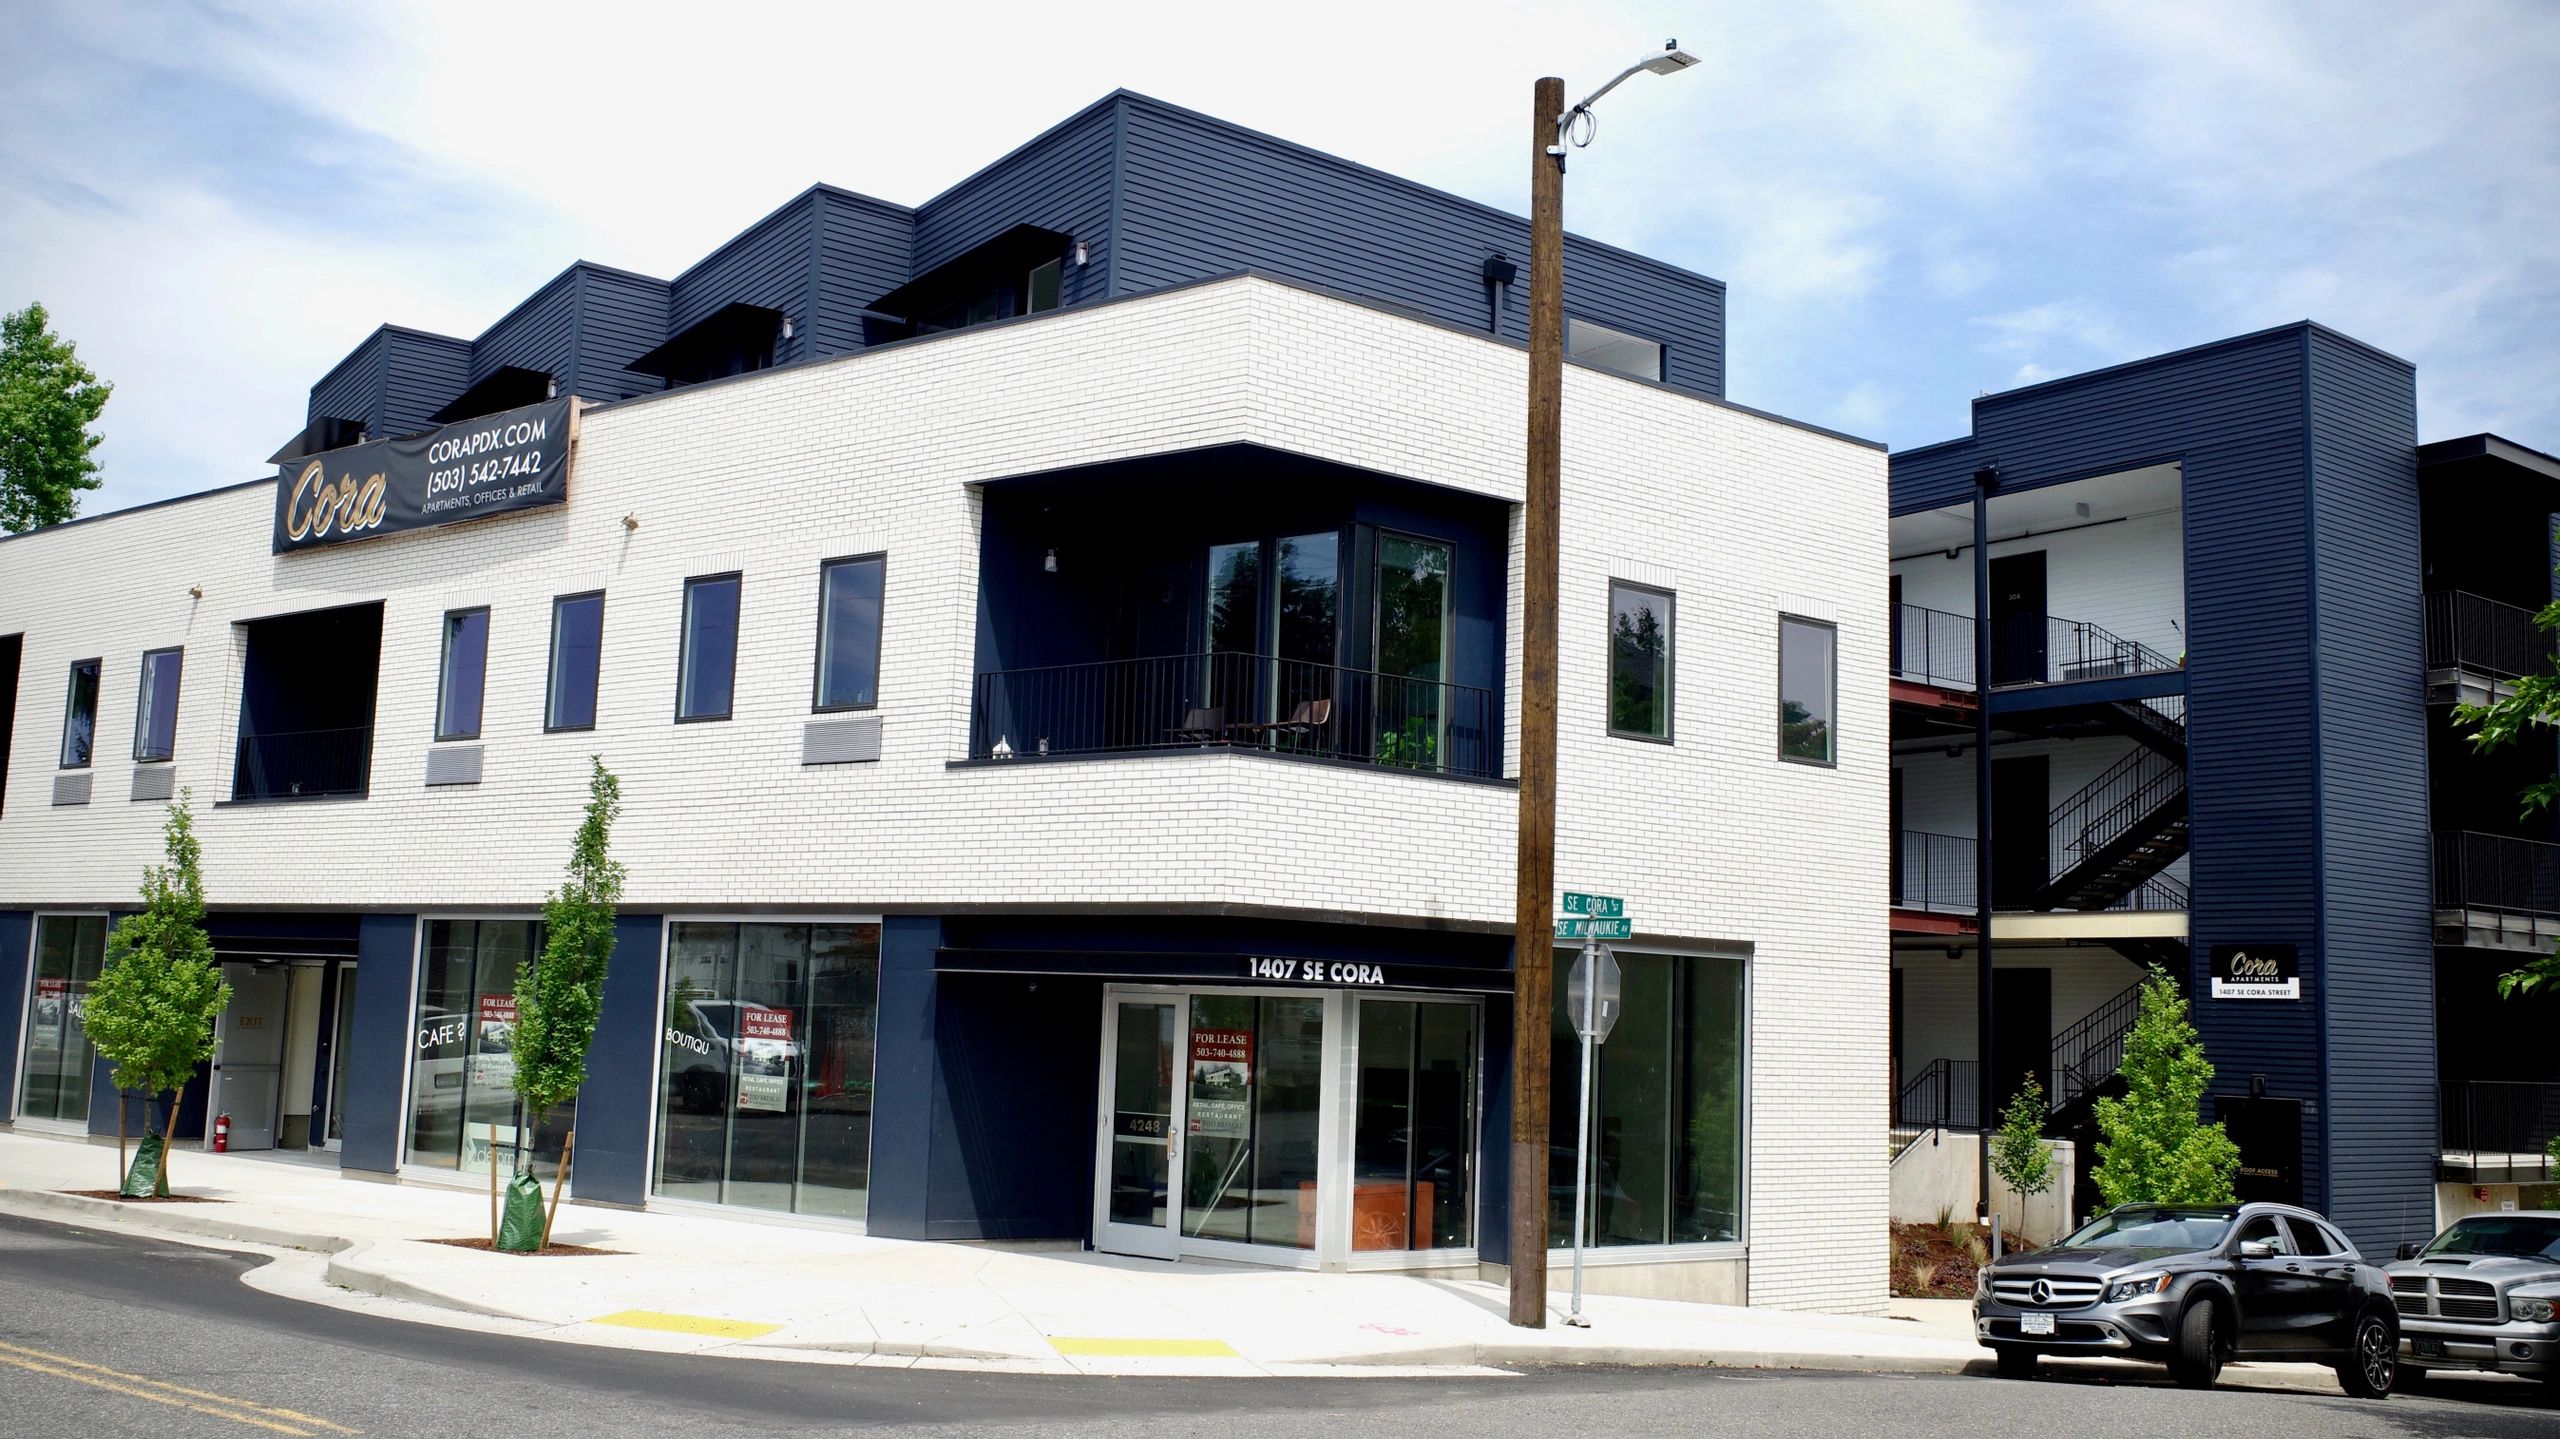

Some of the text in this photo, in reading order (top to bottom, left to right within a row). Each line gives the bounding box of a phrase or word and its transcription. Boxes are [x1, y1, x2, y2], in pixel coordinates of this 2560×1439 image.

[428, 417, 546, 464] CORAPDX.COM
[427, 450, 541, 499] (503) 542-7442
[286, 459, 386, 541] Cora
[421, 481, 544, 515] APARTMENTS, OFFICES & RETAIL
[1567, 895, 1579, 911] SE
[1586, 897, 1608, 914] CORA
[1557, 921, 1569, 935] SE
[1574, 920, 1620, 935] MILWAUKIE
[1250, 957, 1385, 984] 1407 SE CORA
[2230, 951, 2279, 976] Cora
[483, 998, 516, 1008] FOR LEASE
[240, 1016, 264, 1026] EXIT
[746, 1012, 788, 1024] FOR LEASE
[418, 1024, 454, 1049] CAFE
[1195, 1033, 1248, 1045] FOR LEASE
[1196, 1047, 1247, 1059] 503-740-4888
[1197, 1111, 1243, 1120] RESTAURANT
[1130, 1119, 1161, 1133] 4248
